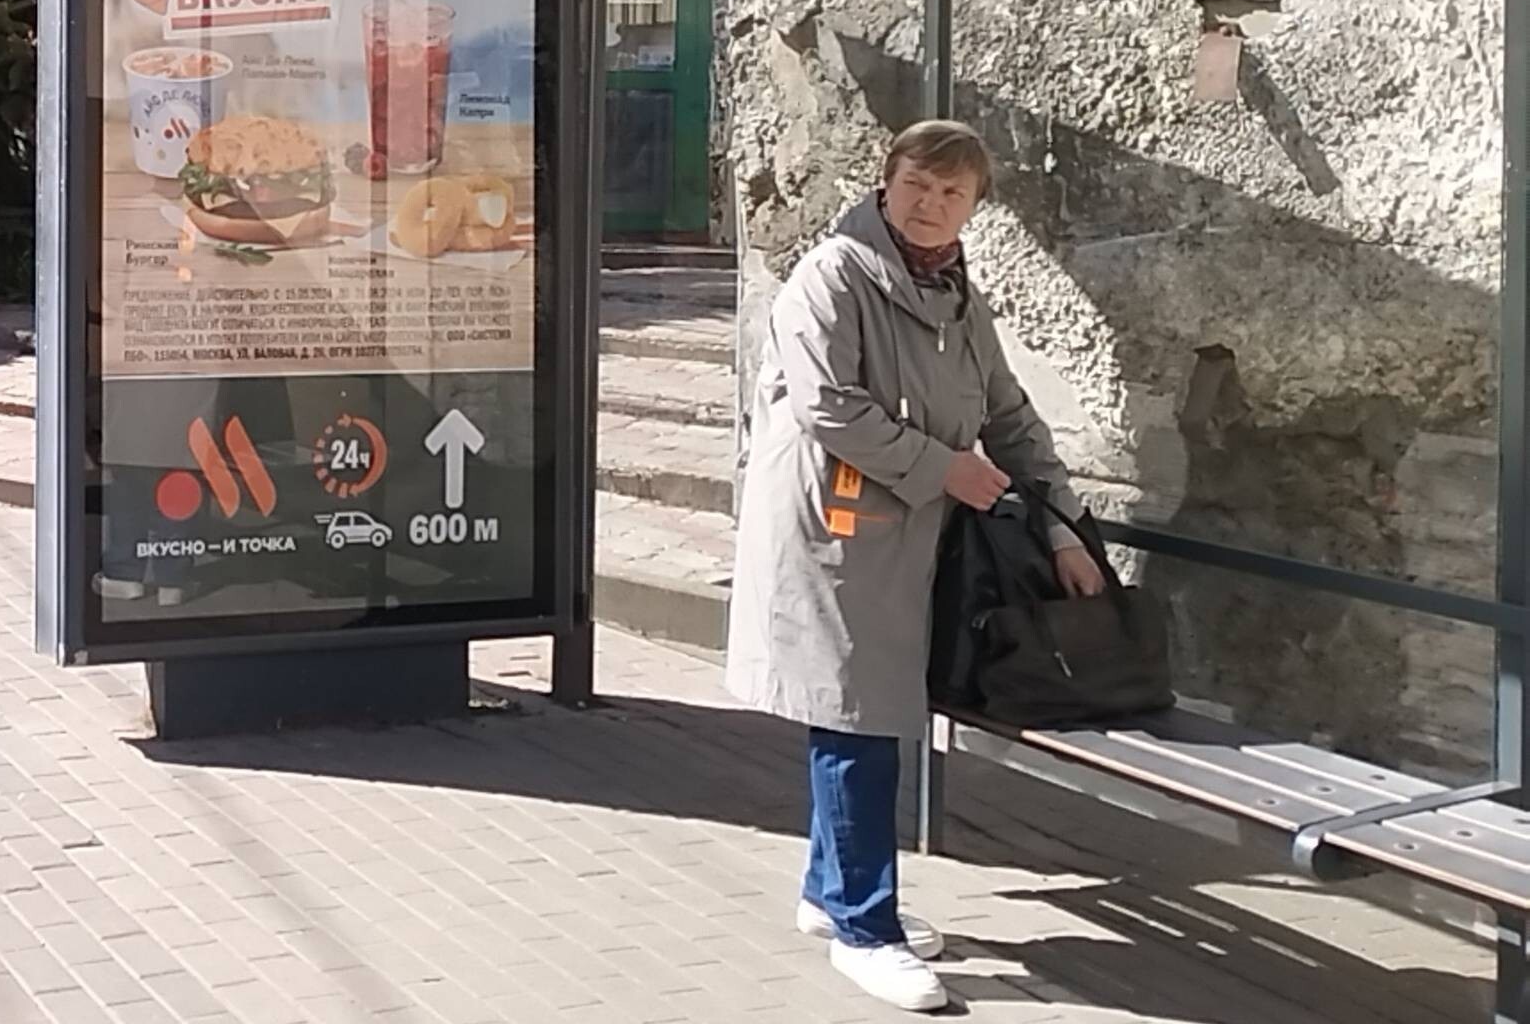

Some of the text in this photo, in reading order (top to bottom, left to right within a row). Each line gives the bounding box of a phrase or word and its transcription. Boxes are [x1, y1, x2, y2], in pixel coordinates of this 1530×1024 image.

[409, 514, 466, 545] 600
[136, 540, 204, 557] ВКУСНО
[239, 537, 297, 554] ТОЧКА
